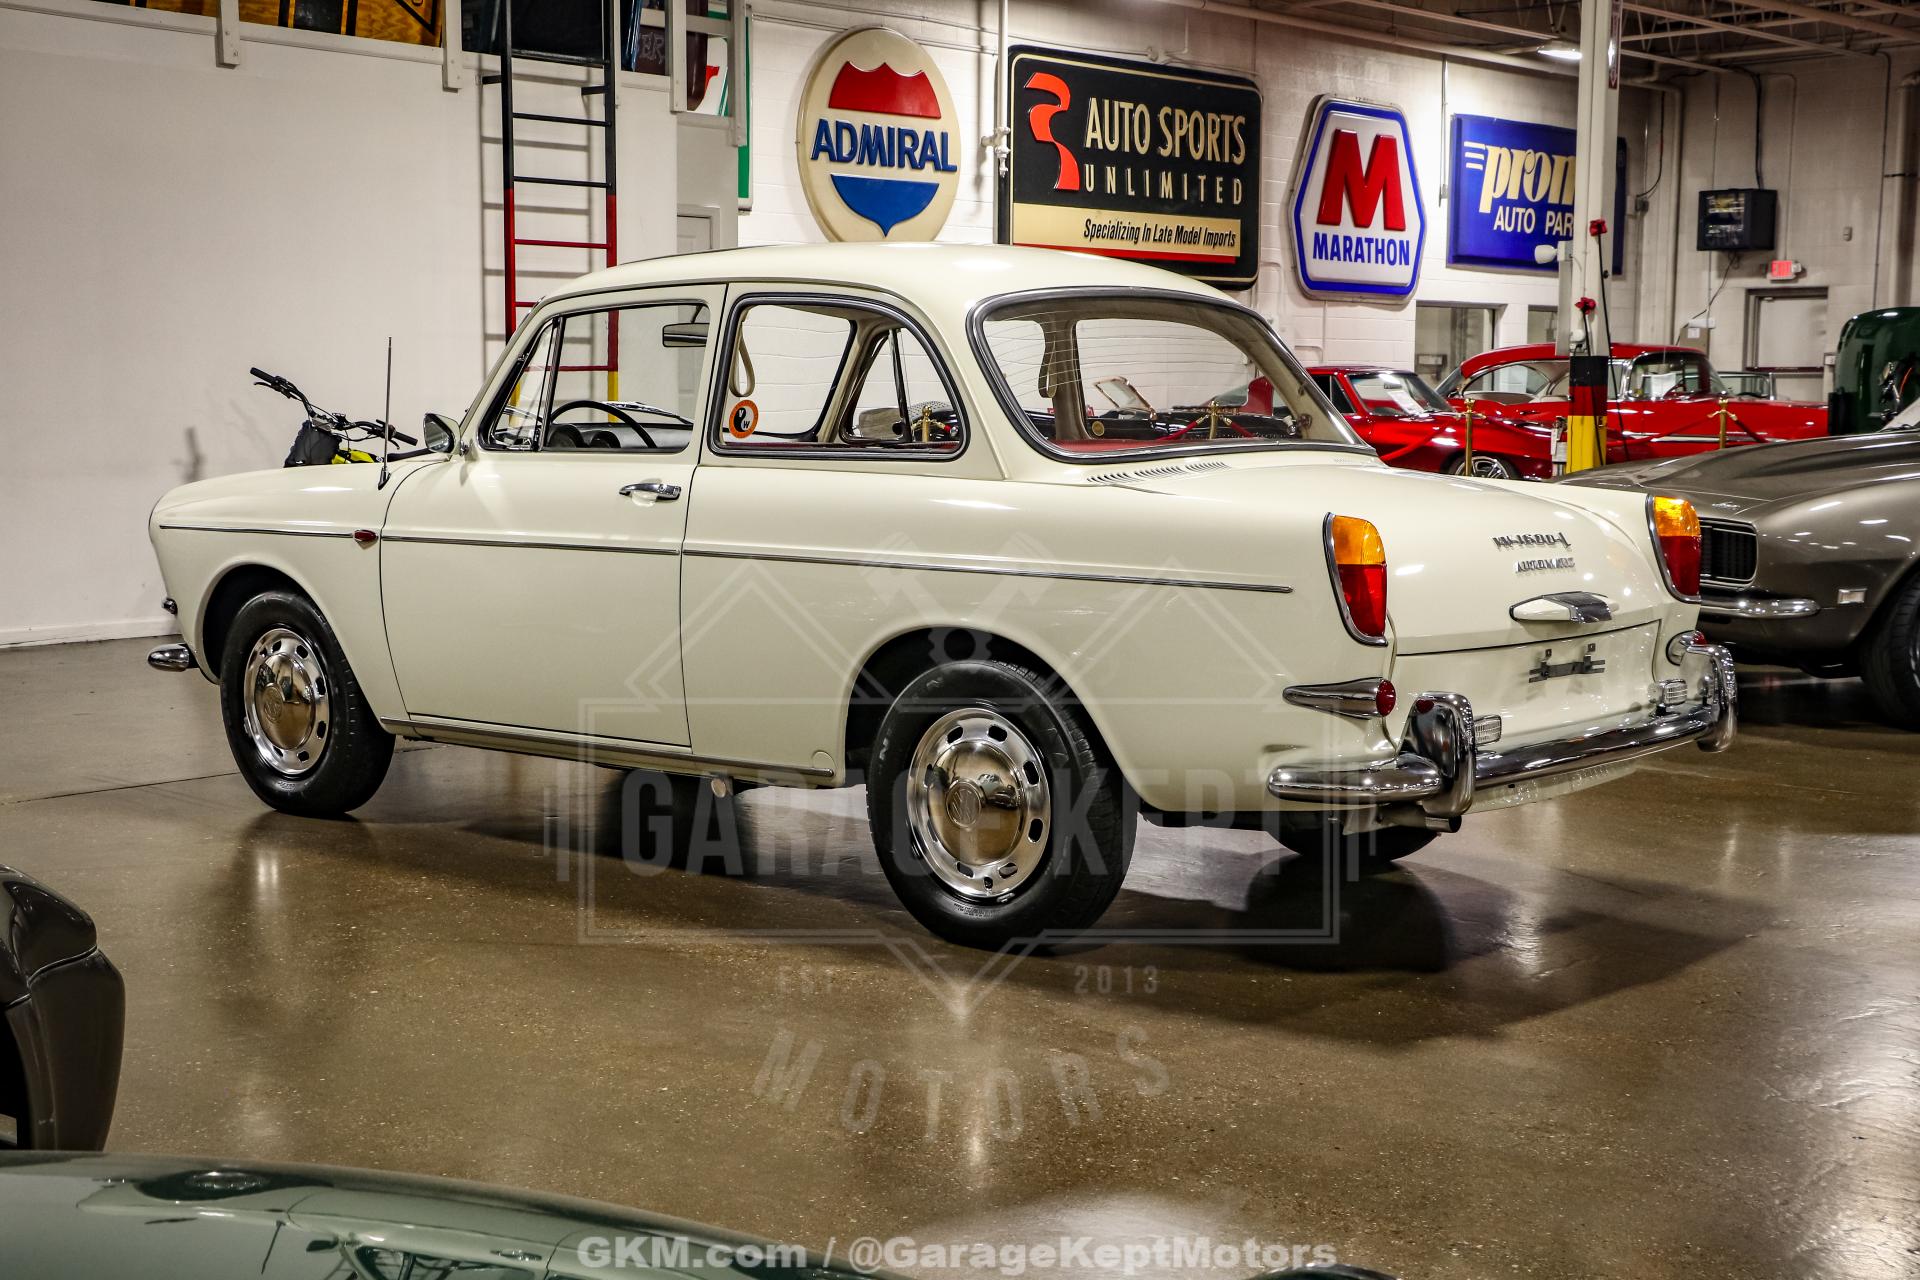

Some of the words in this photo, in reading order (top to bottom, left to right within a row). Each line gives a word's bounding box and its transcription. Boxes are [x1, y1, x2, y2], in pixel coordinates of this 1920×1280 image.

[810, 118, 958, 172] ADMIRAL
[1085, 97, 1151, 155] AUTO
[1158, 106, 1246, 165] SPORTS
[1084, 163, 1243, 205] UNLIMITED
[1316, 129, 1406, 231] M
[1084, 218, 1141, 244] Specializing
[1142, 223, 1151, 242] In
[1153, 224, 1173, 243] Late
[1174, 225, 1202, 245] Model
[1203, 227, 1237, 249] Imports
[1493, 205, 1536, 234] AUTO
[1545, 210, 1574, 237] PAR
[1313, 231, 1410, 266] MARATHON
